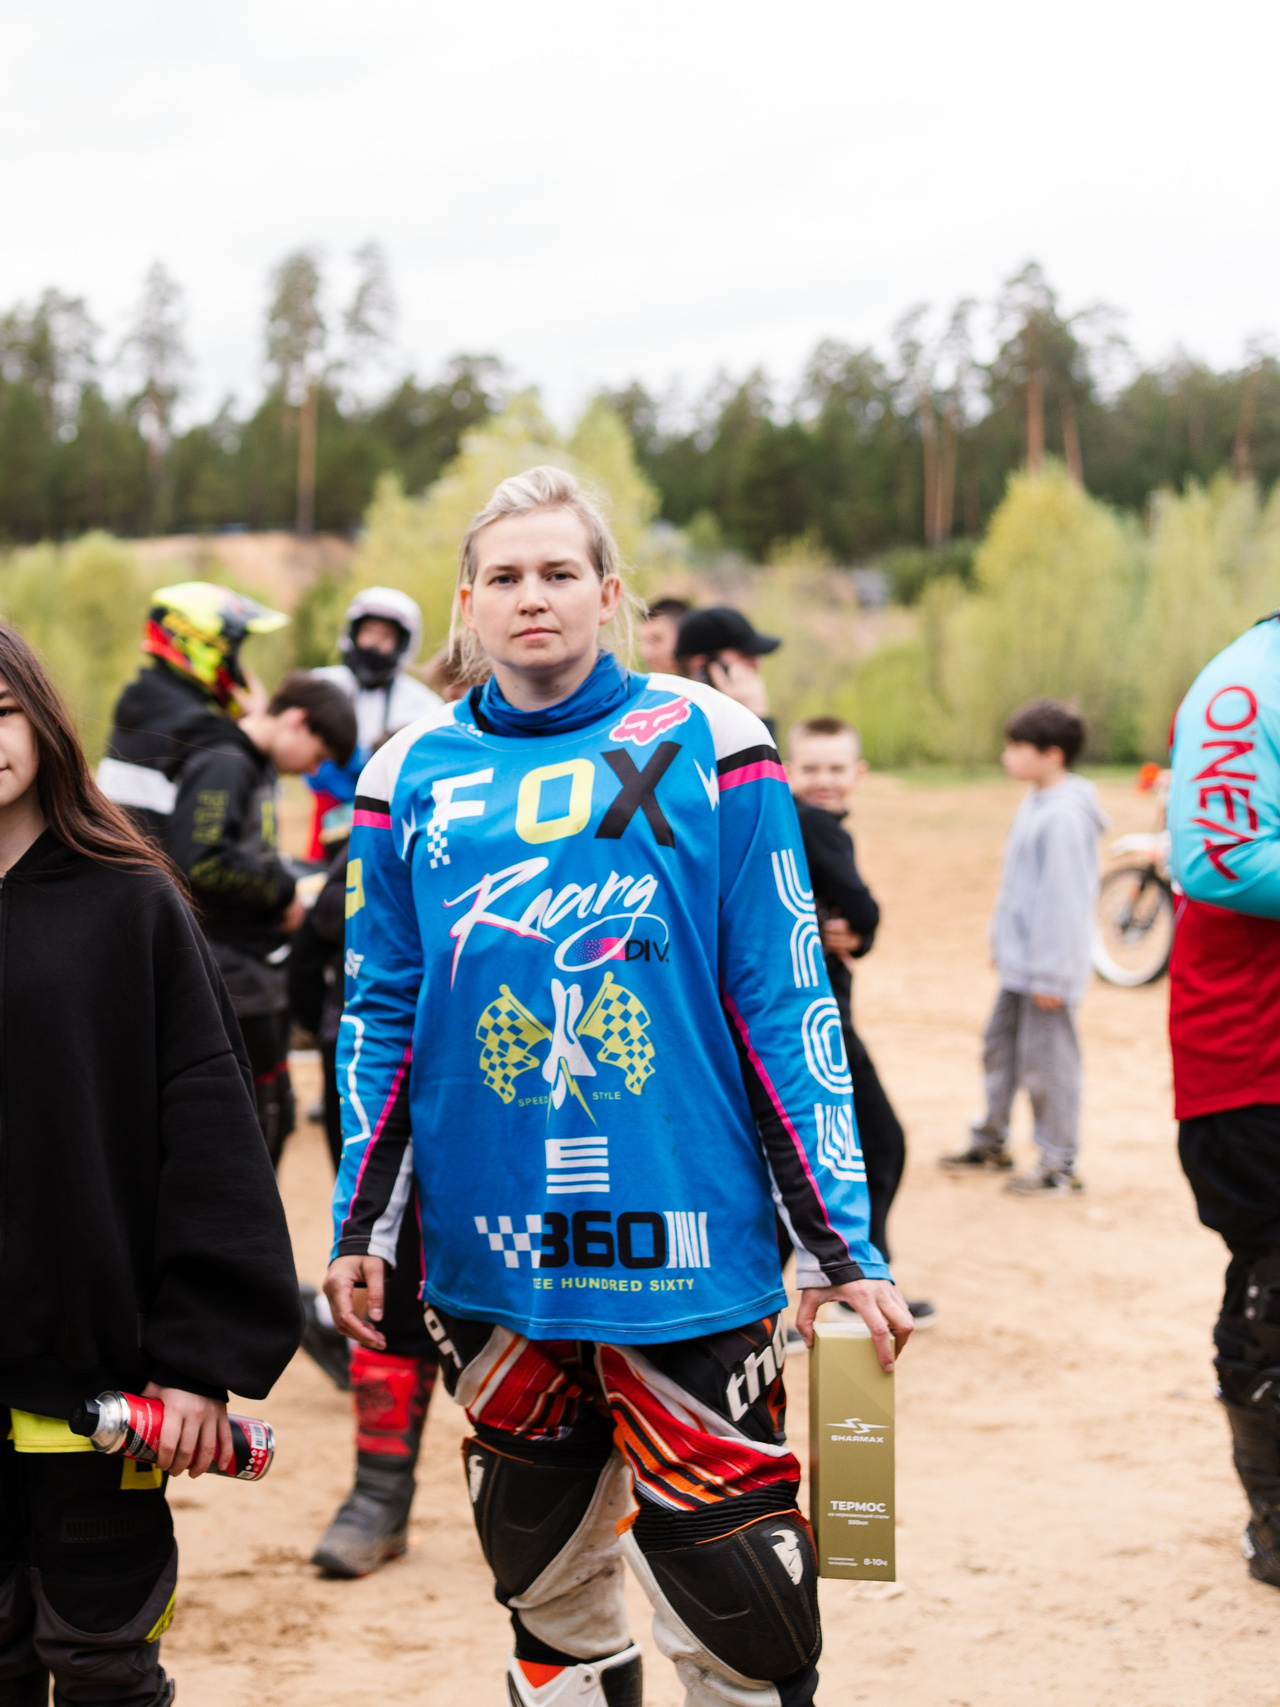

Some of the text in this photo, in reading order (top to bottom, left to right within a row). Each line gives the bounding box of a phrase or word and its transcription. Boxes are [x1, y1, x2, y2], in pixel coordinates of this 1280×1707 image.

[427, 741, 683, 869] FOX
[592, 1091, 622, 1101] STYLE
[538, 1210, 666, 1269] 360
[561, 1278, 643, 1292] HUNDRED
[649, 1278, 695, 1292] SIXTY
[423, 1308, 464, 1369] or
[726, 1311, 788, 1422] tho
[829, 1500, 887, 1513] ТЕРМОС
